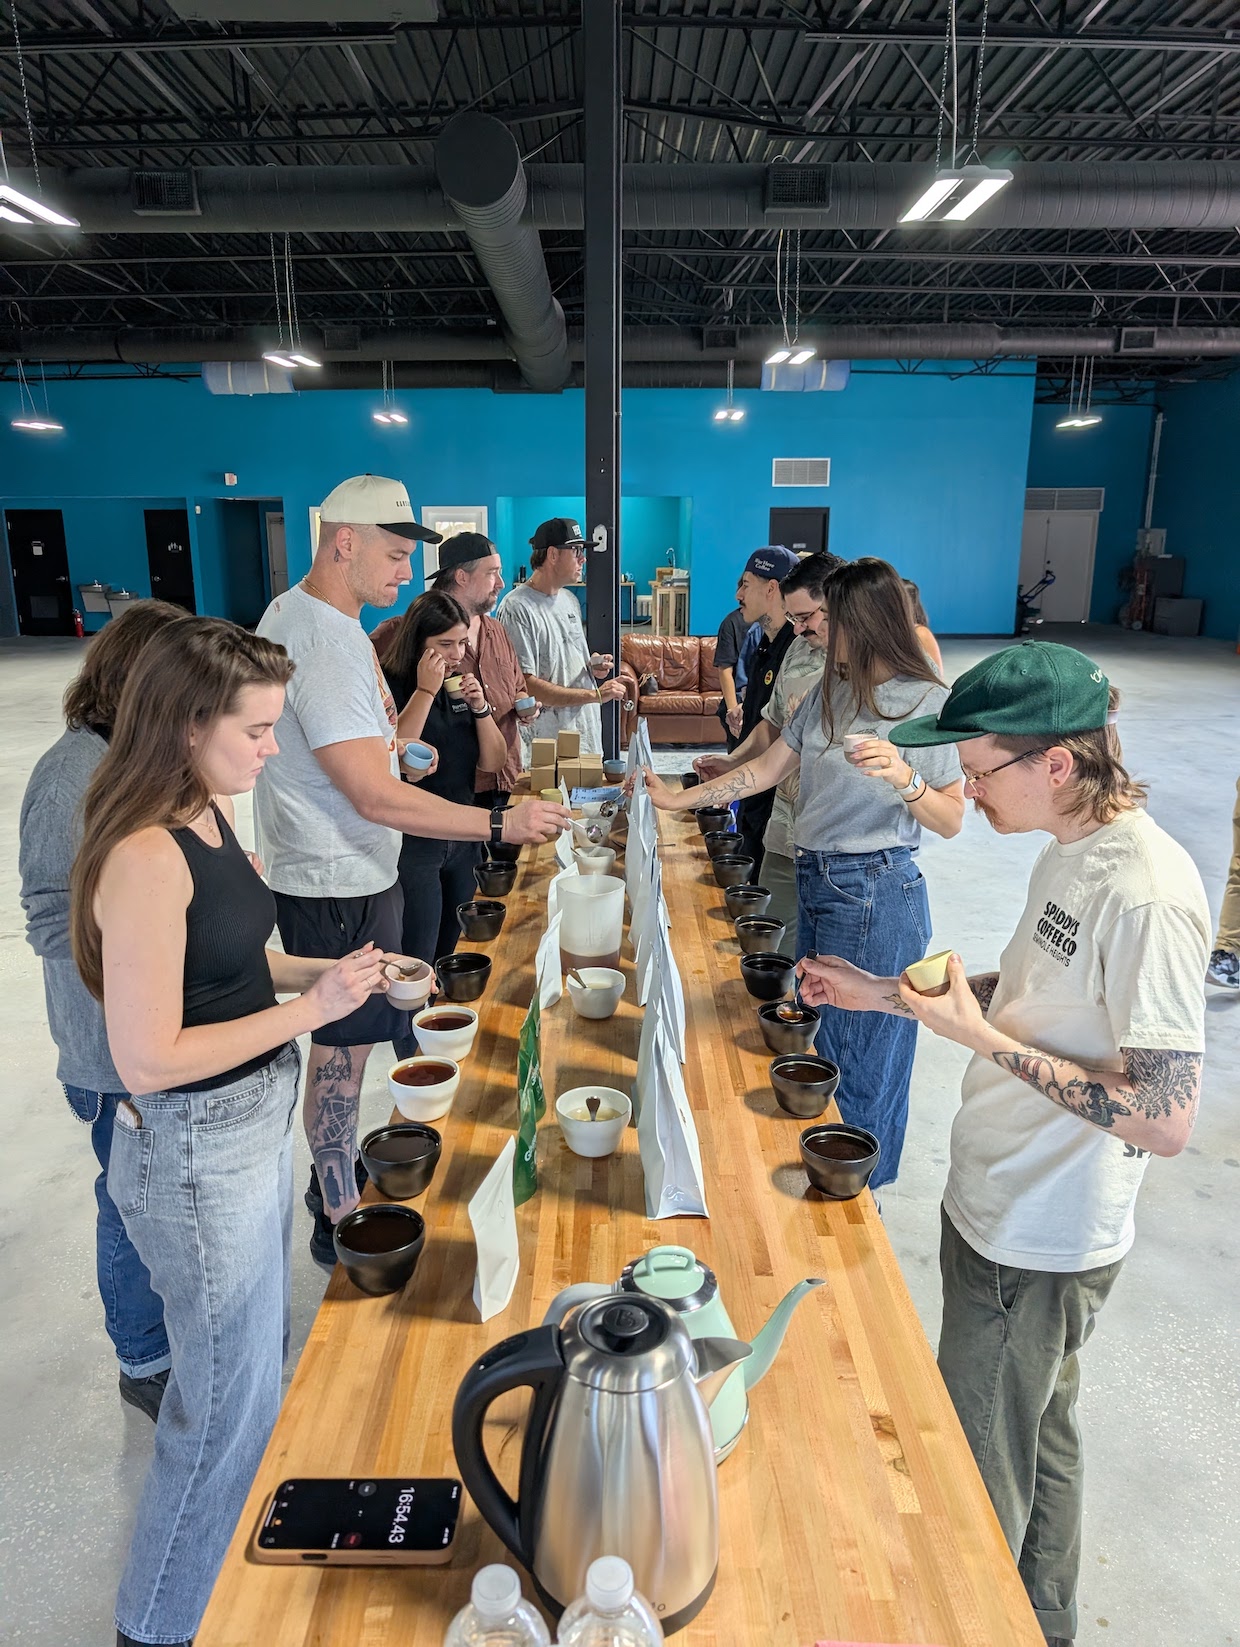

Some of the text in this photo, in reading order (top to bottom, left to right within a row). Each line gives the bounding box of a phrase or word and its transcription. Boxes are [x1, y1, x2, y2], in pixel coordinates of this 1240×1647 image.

[1037, 917, 1077, 957] COFFEE CO
[1049, 946, 1071, 968] HEIGHTS
[388, 1486, 415, 1544] 16:54.43
